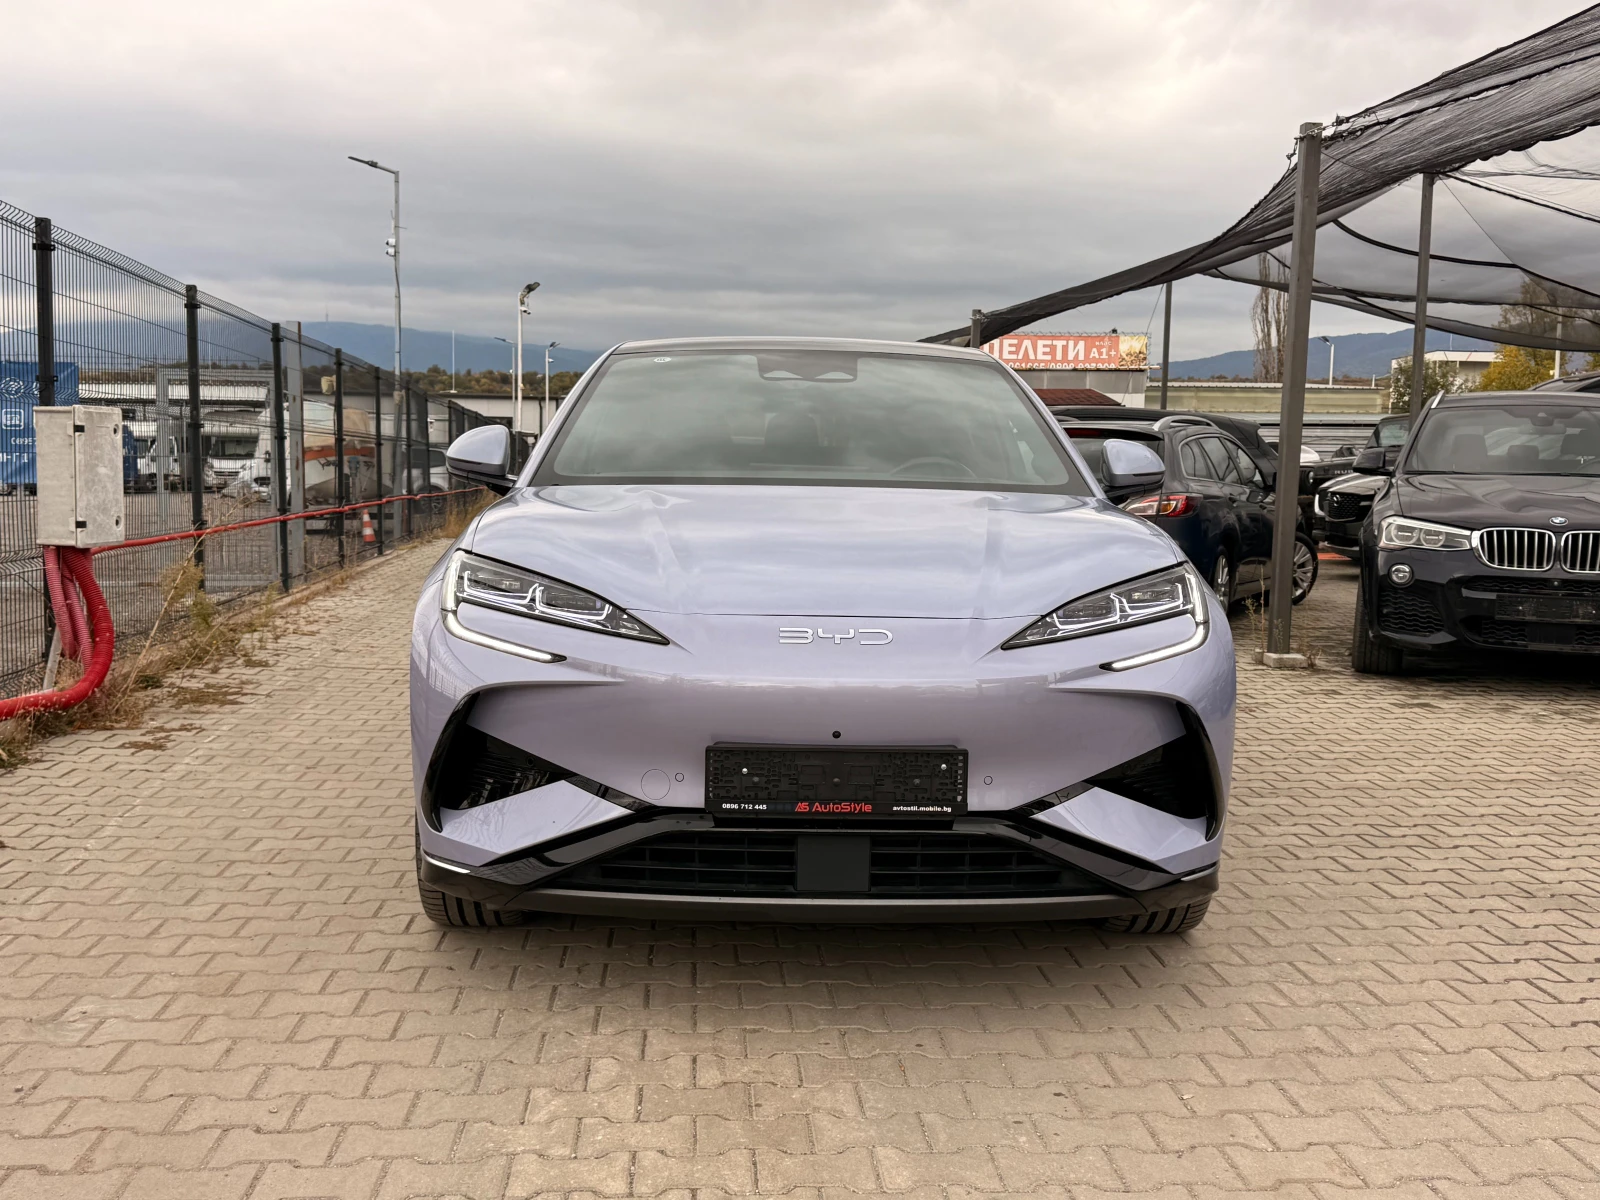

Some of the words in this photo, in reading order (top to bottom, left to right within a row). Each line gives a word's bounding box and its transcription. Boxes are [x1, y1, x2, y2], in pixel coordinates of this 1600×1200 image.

[779, 627, 893, 645] BYD
[812, 802, 872, 813] AutoStyle
[892, 805, 952, 813] avtostil.mobile.bg
